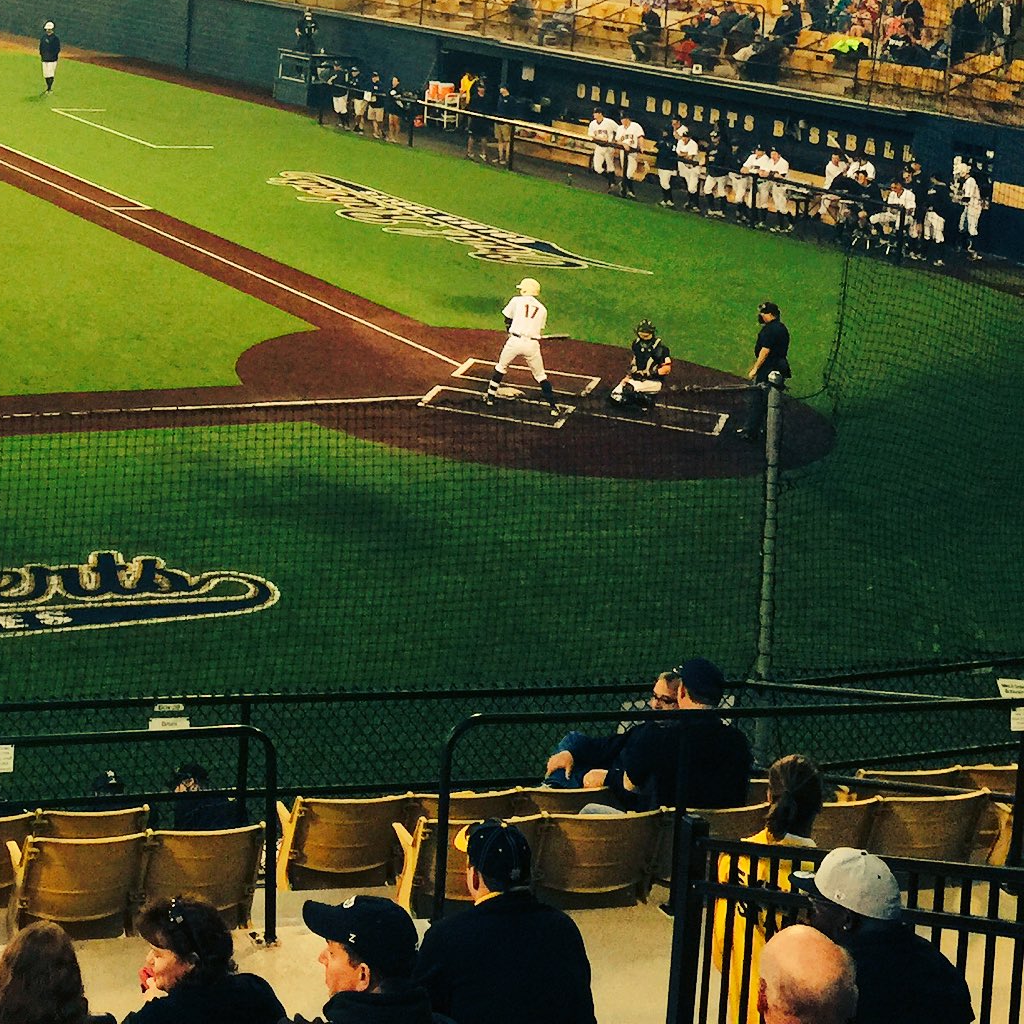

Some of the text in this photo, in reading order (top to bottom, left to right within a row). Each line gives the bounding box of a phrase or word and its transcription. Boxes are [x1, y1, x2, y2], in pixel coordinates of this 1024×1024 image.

[577, 83, 913, 163] ORAL ROBERTS BSEBALL
[525, 304, 539, 319] 17
